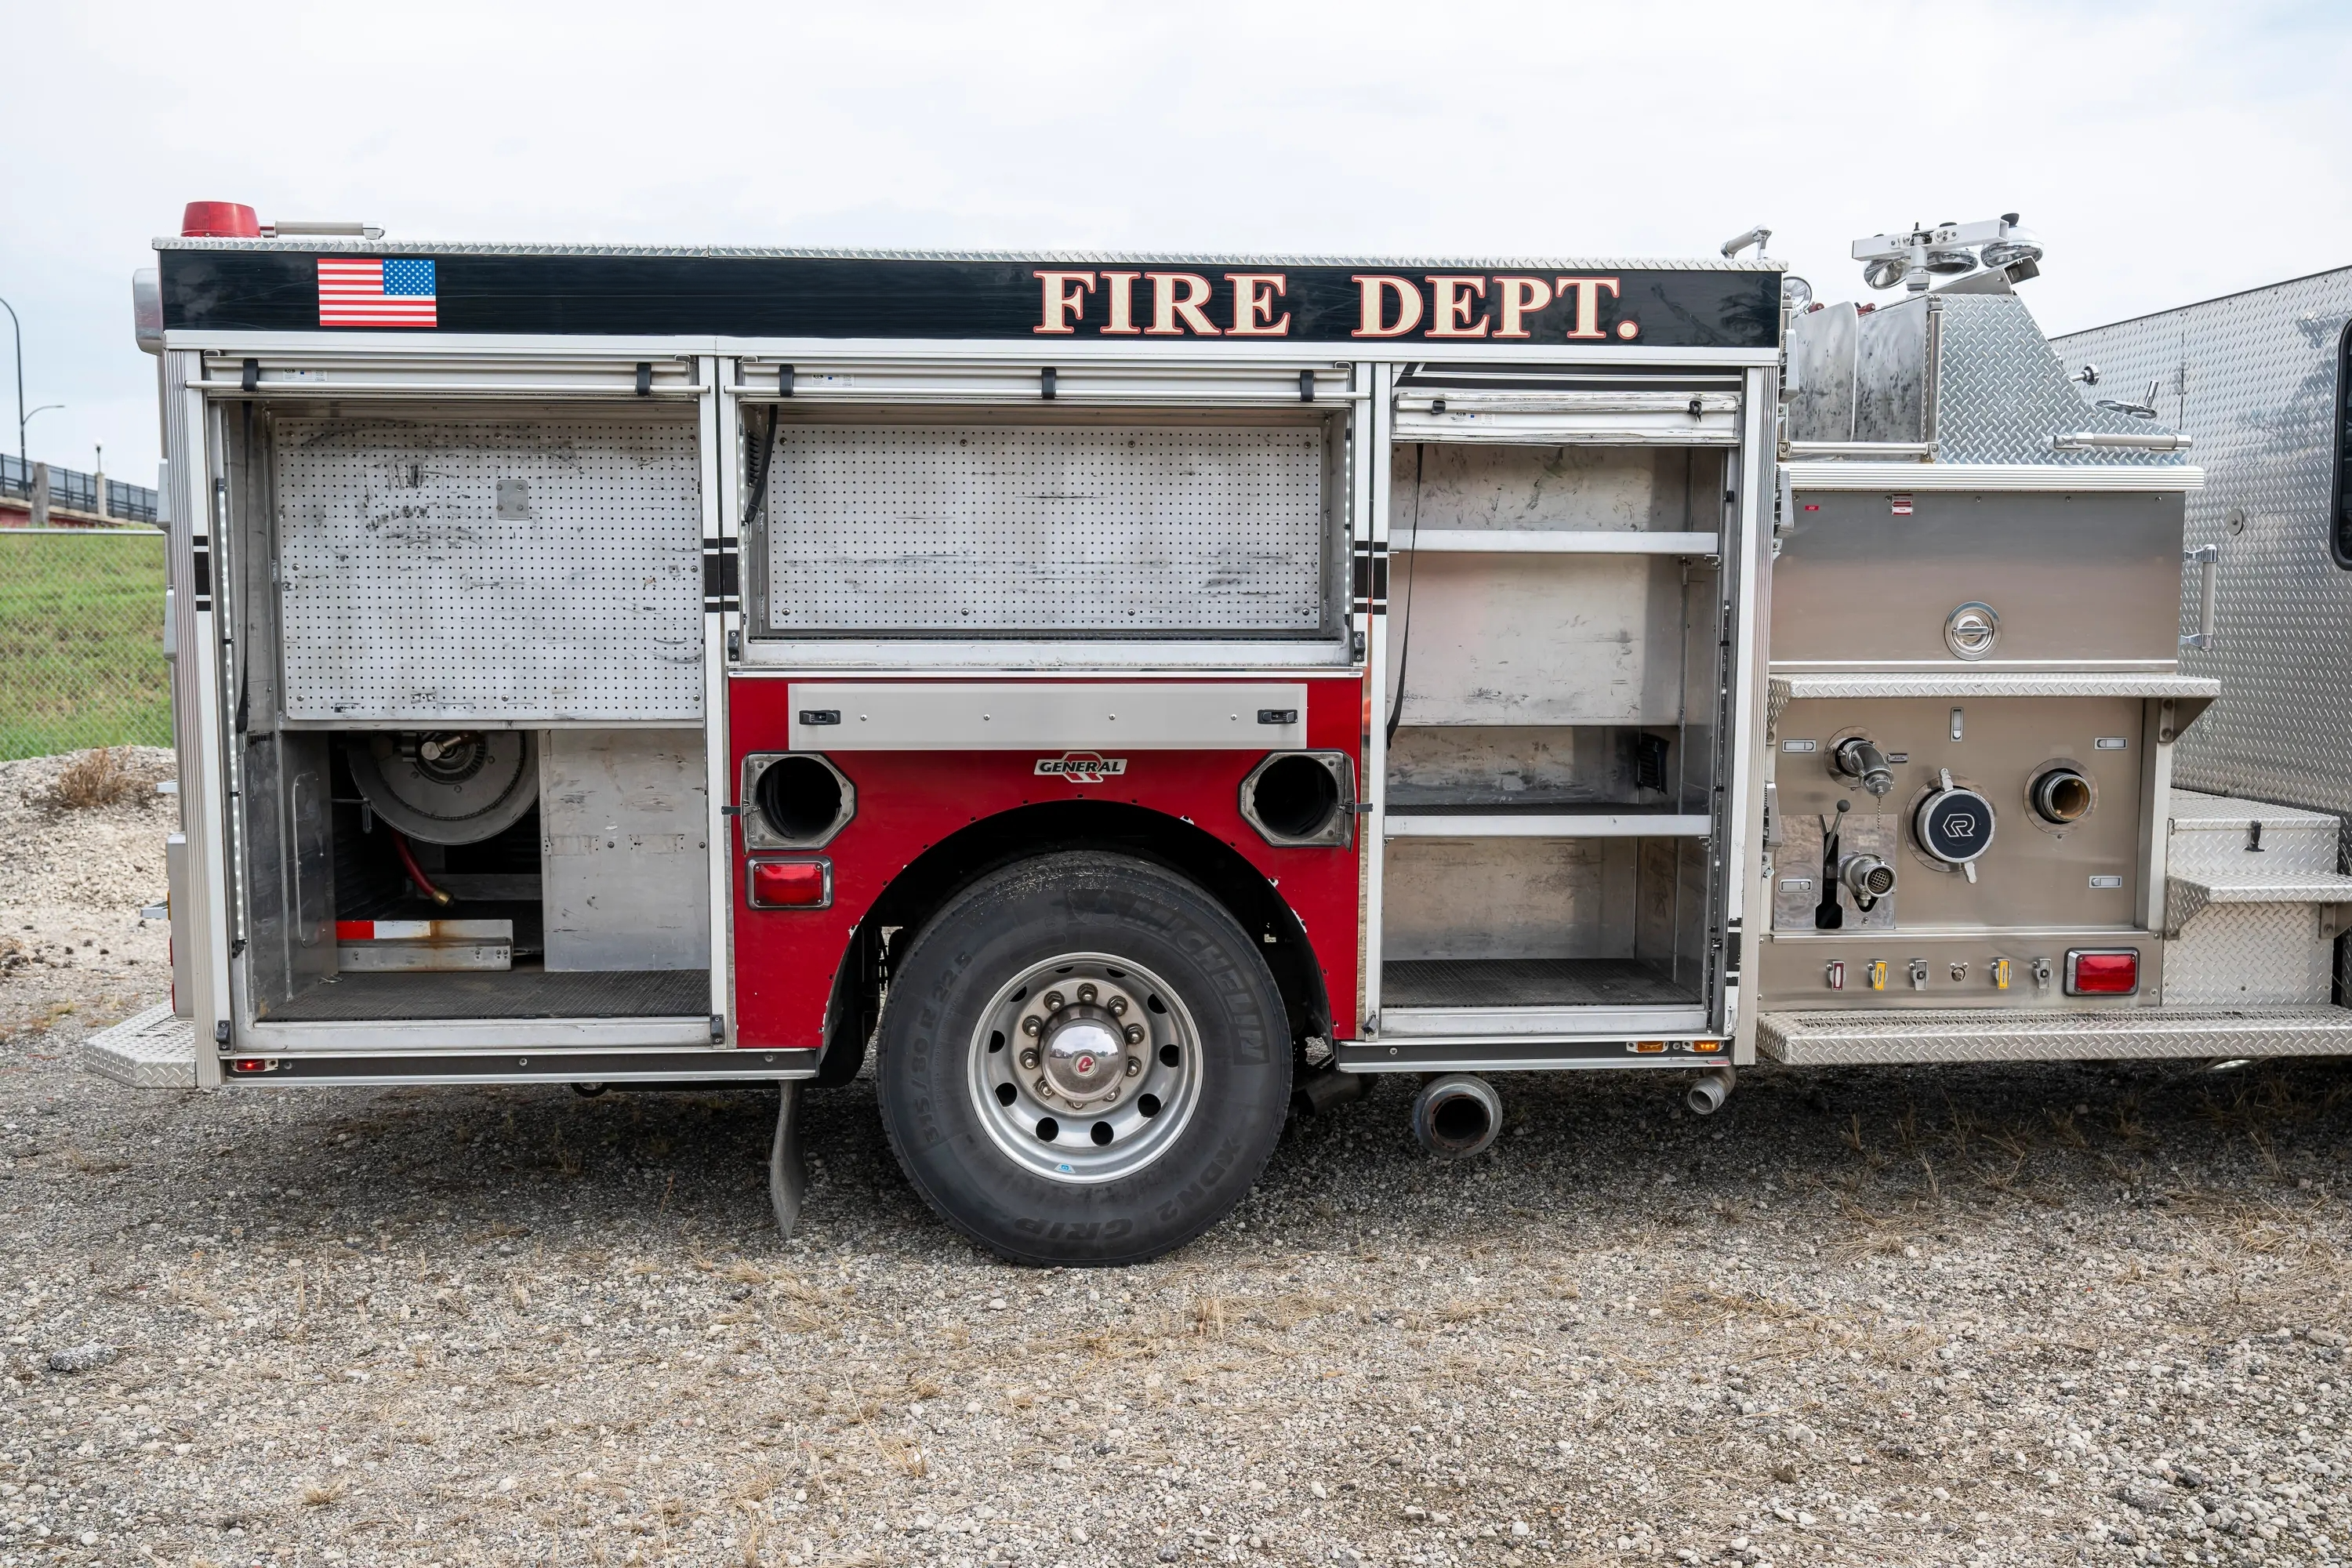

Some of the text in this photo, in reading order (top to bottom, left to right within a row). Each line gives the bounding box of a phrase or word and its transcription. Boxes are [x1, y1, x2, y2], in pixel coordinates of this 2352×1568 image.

[1033, 270, 1639, 339] FIRE DEPT.
[1040, 761, 1121, 772] GENERAL
[1015, 1137, 1243, 1240] XDN2 GRIP
